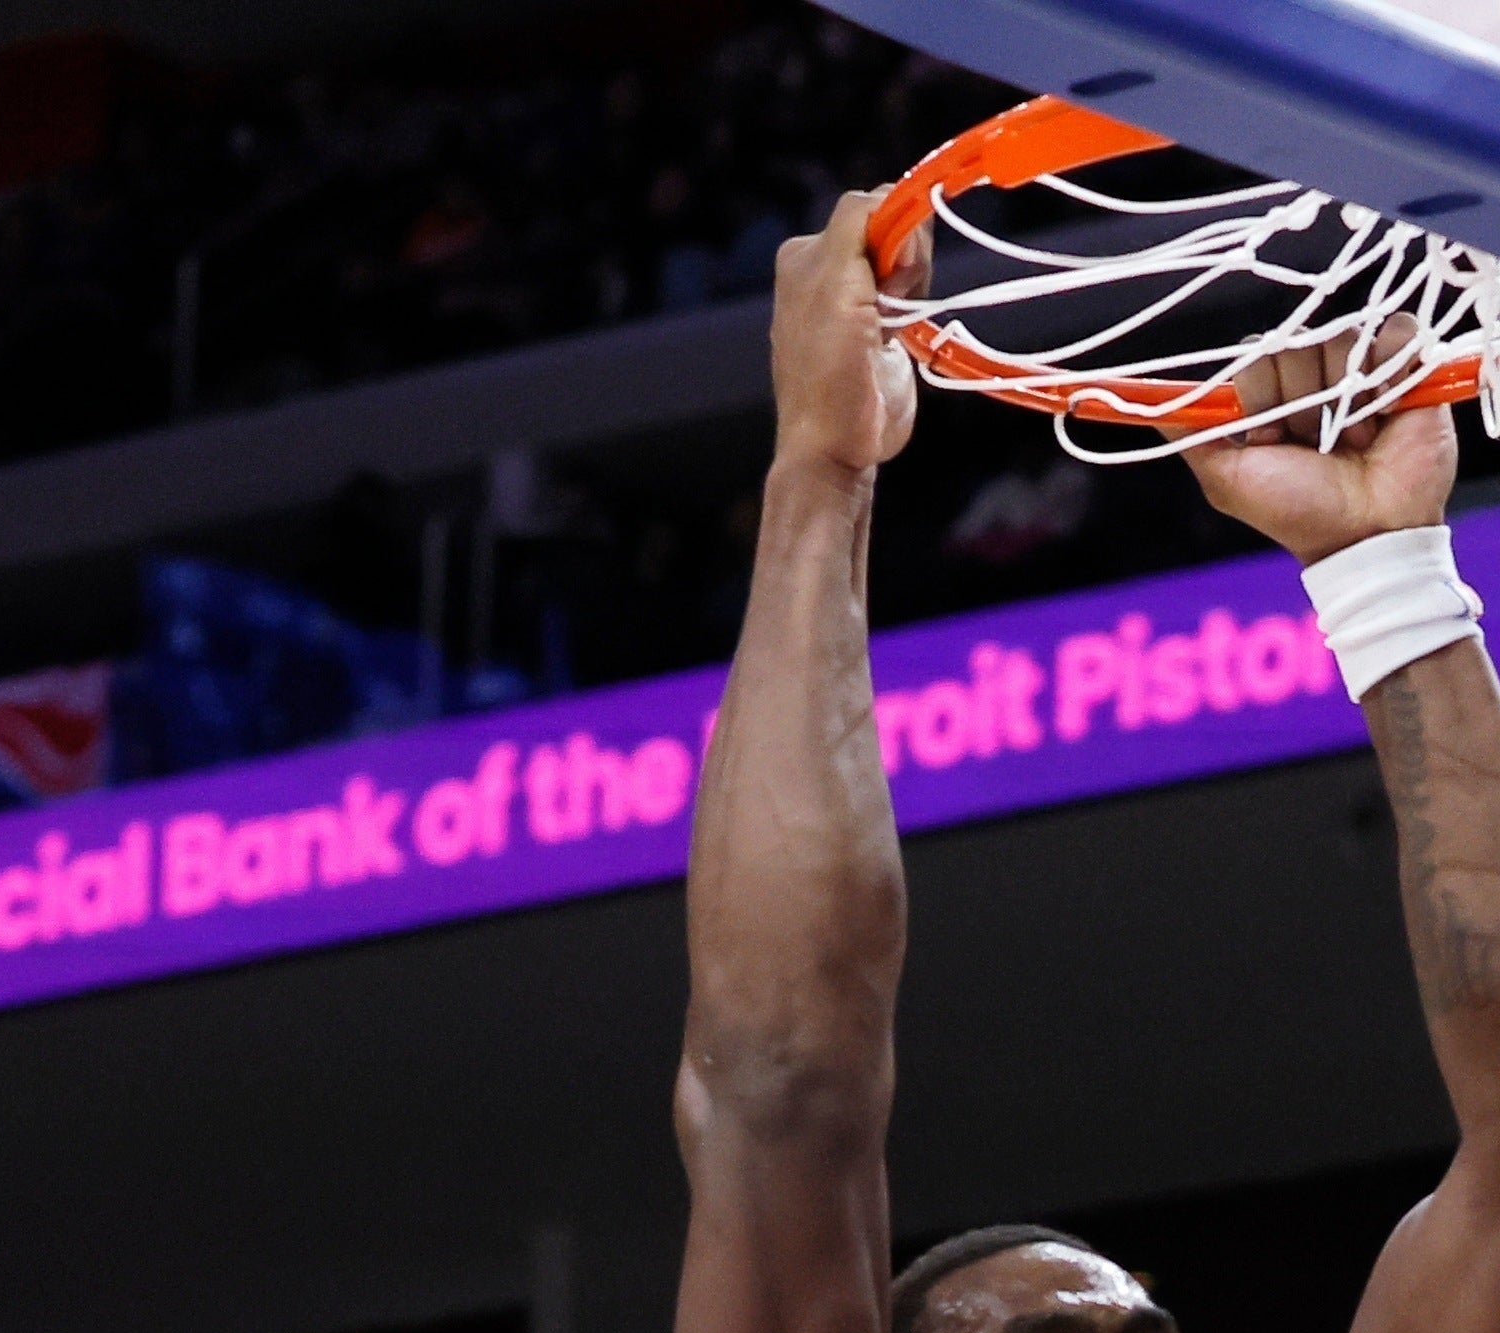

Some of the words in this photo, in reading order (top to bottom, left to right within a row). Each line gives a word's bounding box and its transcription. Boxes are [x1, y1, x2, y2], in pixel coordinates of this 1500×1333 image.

[160, 776, 405, 918] Bank
[411, 742, 519, 867] of
[521, 732, 693, 844] the
[1054, 609, 1337, 741] Pisto
